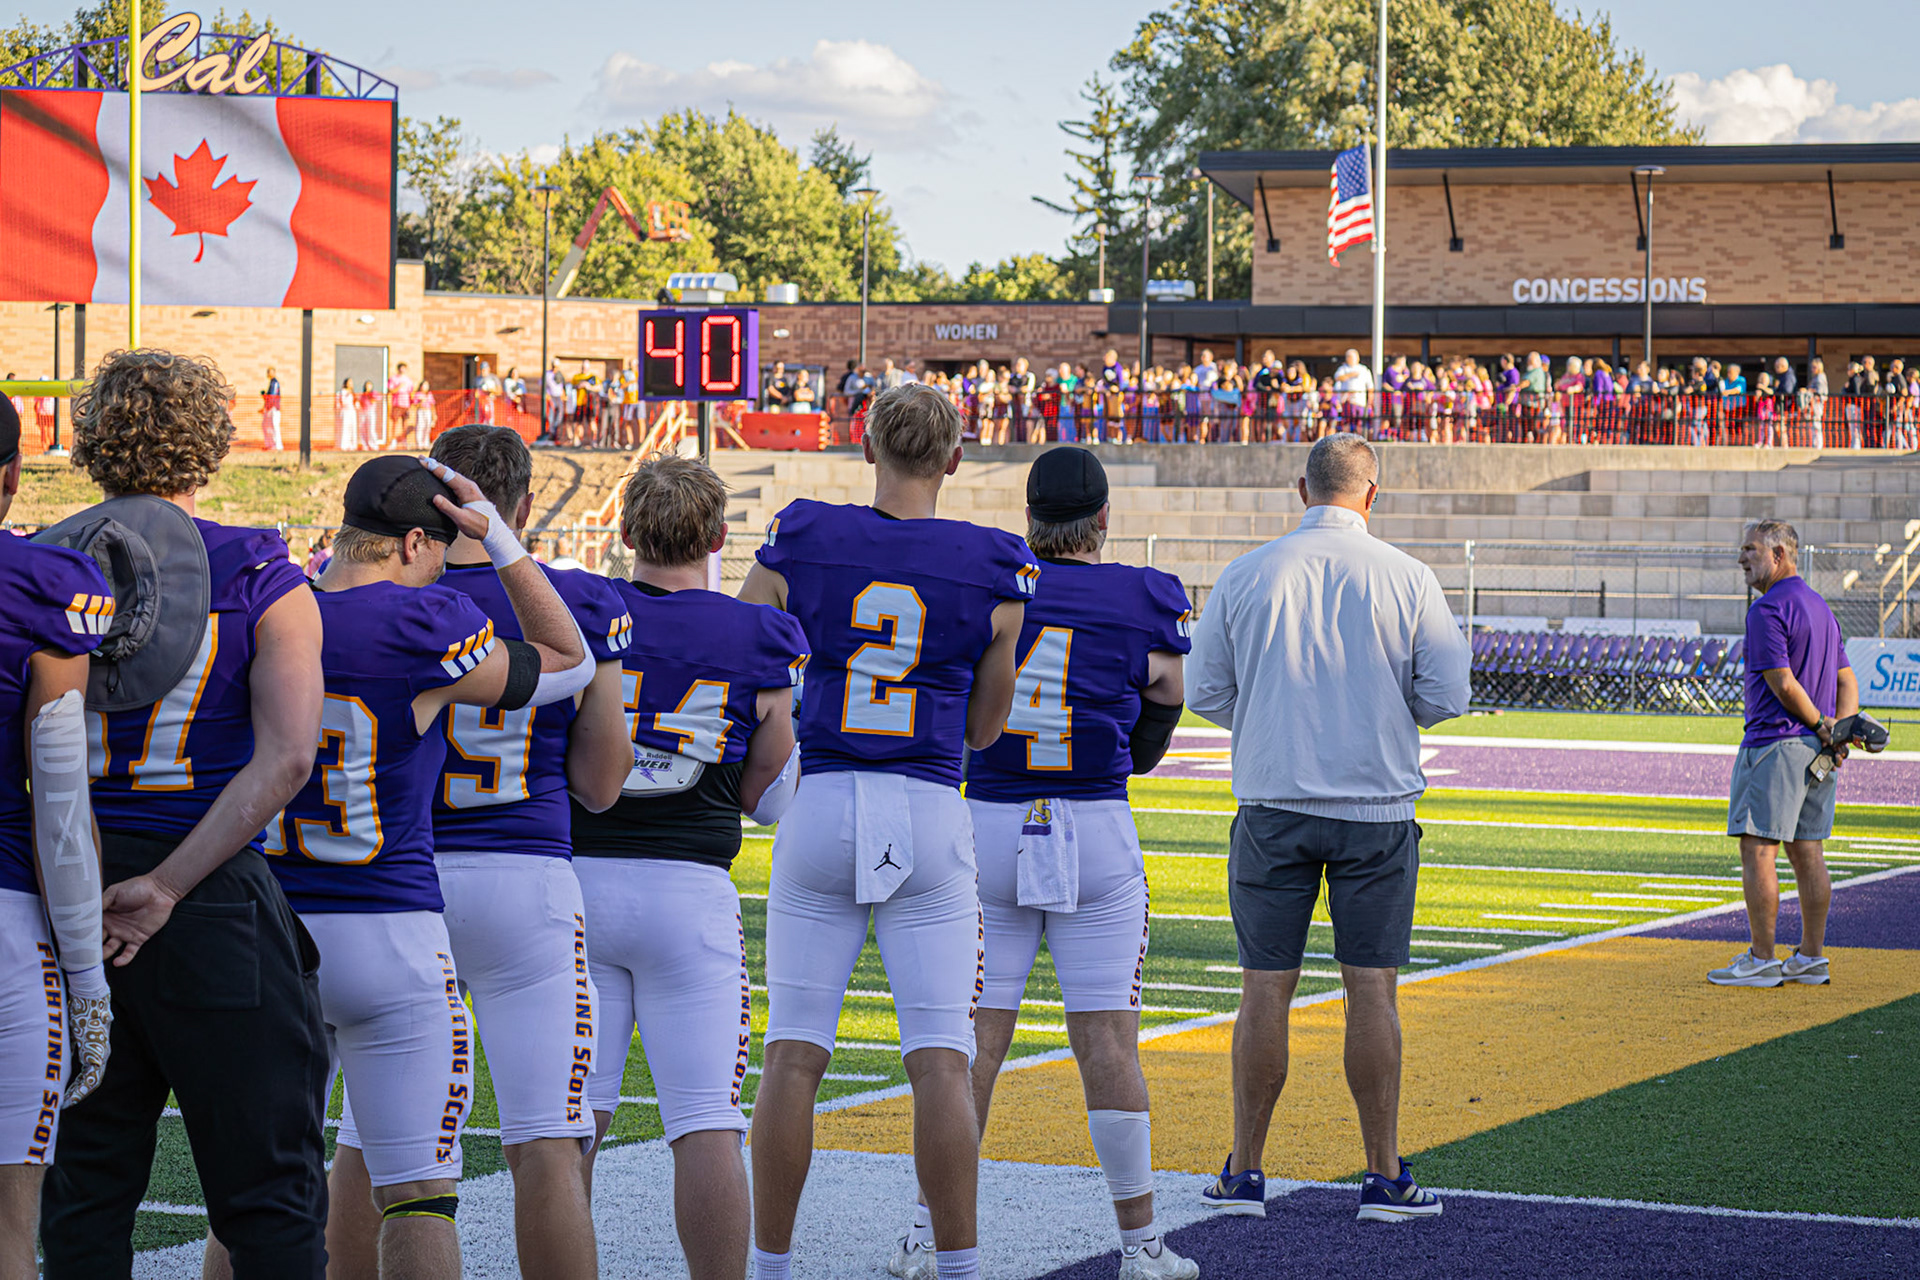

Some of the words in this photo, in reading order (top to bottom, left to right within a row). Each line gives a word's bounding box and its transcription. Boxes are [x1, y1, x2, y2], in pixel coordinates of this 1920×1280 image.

[125, 12, 271, 94] Cal
[1513, 278, 1706, 303] CONCESSIONS
[645, 315, 741, 391] 40
[935, 323, 998, 340] WOMEN
[841, 581, 927, 737] 2
[1003, 626, 1073, 771] 4
[1870, 653, 1920, 692] SHE
[264, 692, 384, 865] 3
[634, 759, 671, 770] WER
[37, 941, 62, 1082] FIGHTING
[436, 951, 470, 1075] FIGHTING
[574, 912, 593, 1038] FIGHTING
[566, 1045, 592, 1124] SCOTS
[730, 1033, 750, 1107] SCOTS
[24, 1089, 60, 1166] SCOT
[436, 1083, 468, 1164] SCOTS
